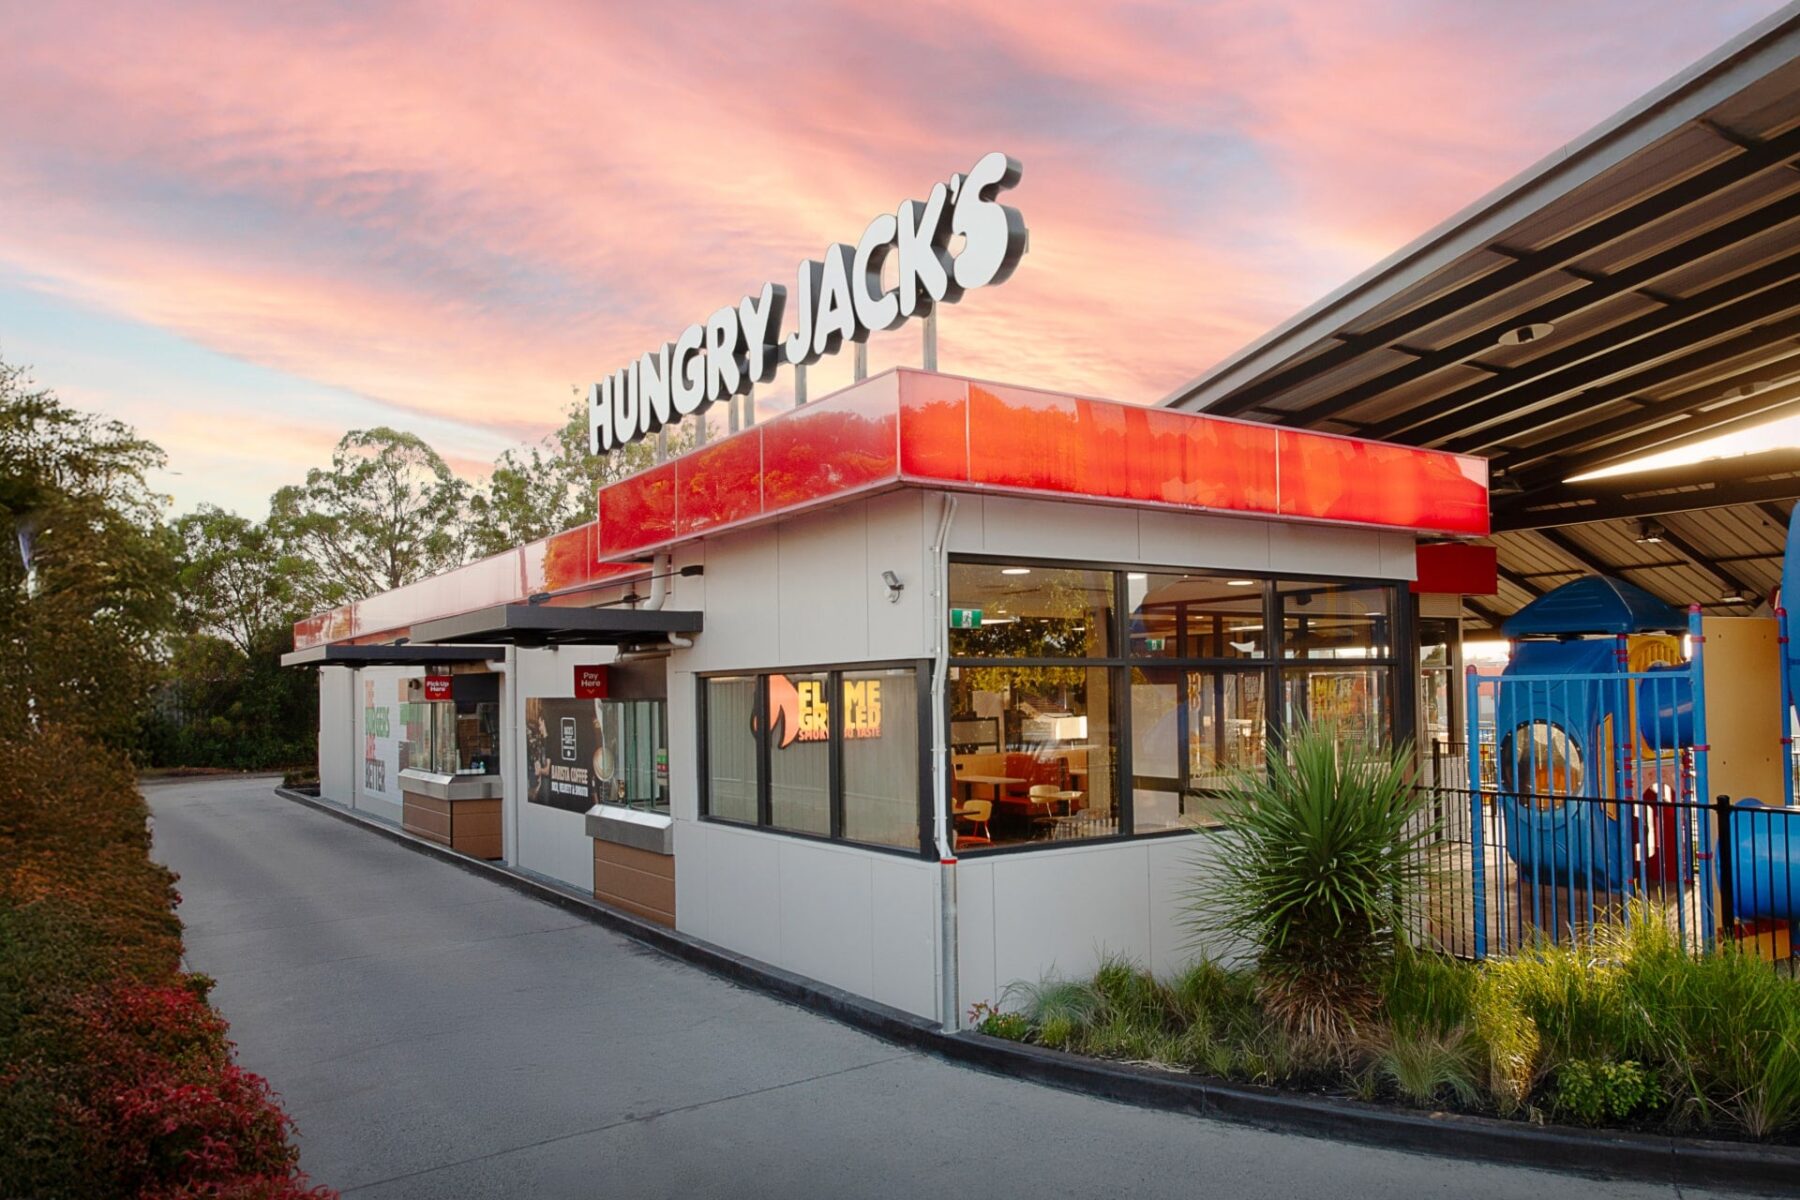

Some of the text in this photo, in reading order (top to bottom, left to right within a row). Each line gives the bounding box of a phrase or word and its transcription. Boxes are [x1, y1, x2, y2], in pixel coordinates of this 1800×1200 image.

[589, 152, 1026, 455] HUNGRY JACK'S
[583, 672, 599, 680] Pay
[570, 767, 588, 785] COFFEE
